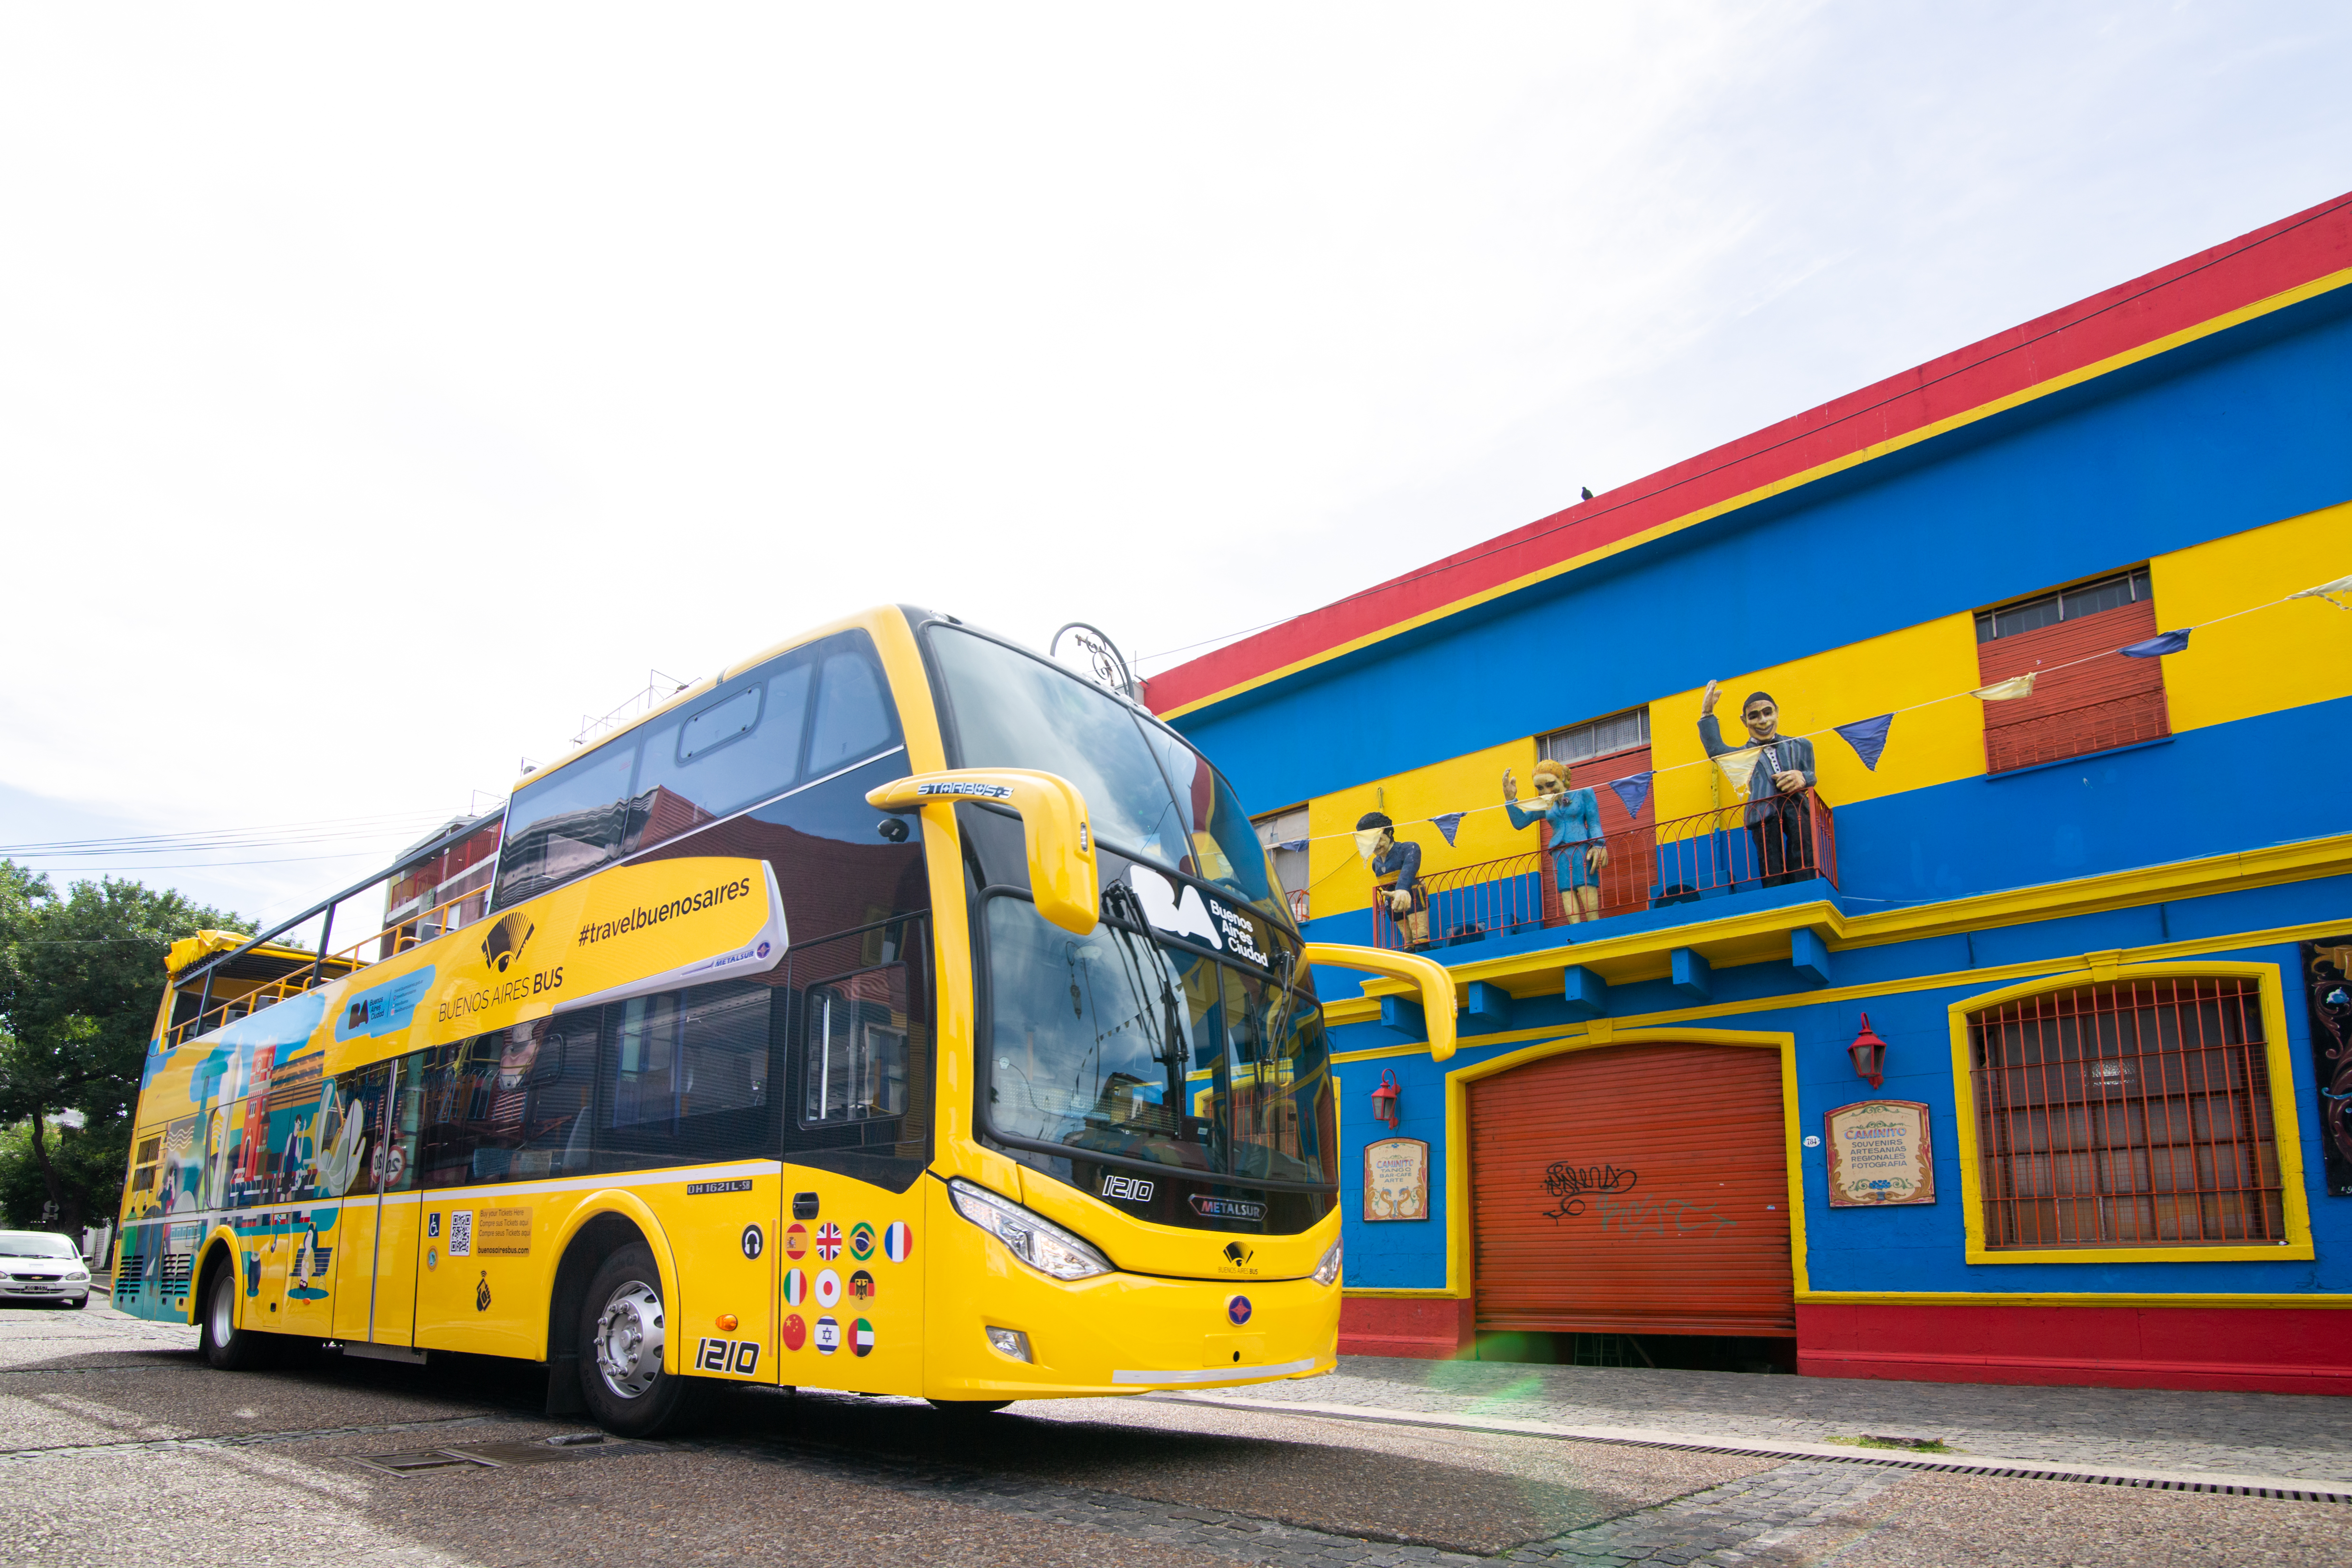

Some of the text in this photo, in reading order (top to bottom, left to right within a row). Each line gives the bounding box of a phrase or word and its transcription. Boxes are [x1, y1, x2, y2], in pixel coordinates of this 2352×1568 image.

[578, 877, 750, 947] #travelbuenosaires
[1130, 865, 1223, 950] BA
[1209, 899, 1254, 933] Buenos
[1222, 920, 1254, 946] Aires
[1228, 936, 1269, 968] Ciudad
[714, 950, 754, 968] METALSUR
[438, 966, 564, 1023] BUENOS AIRES BUS
[370, 997, 384, 1007] Buenos
[371, 1005, 381, 1014] Aires
[371, 1008, 385, 1020] Ciudad
[1844, 1127, 1907, 1140] CAMINITO
[1851, 1139, 1903, 1148] SOUVENIRS
[1850, 1146, 1907, 1155] ARTESANIAS
[1851, 1153, 1906, 1162] REGIONALES
[1376, 1159, 1414, 1169] CAMINITO
[1851, 1160, 1908, 1169] FOTOGRAFIA
[687, 1185, 703, 1194] OH
[1102, 1175, 1154, 1202] 1210
[480, 1210, 488, 1218] Buy
[1200, 1200, 1260, 1217] METALSUR
[479, 1220, 495, 1228] Compre
[519, 1218, 529, 1227] aquí
[478, 1229, 495, 1238] Compre
[478, 1245, 529, 1254] buenosairesbus.com
[694, 1337, 761, 1377] 1210
